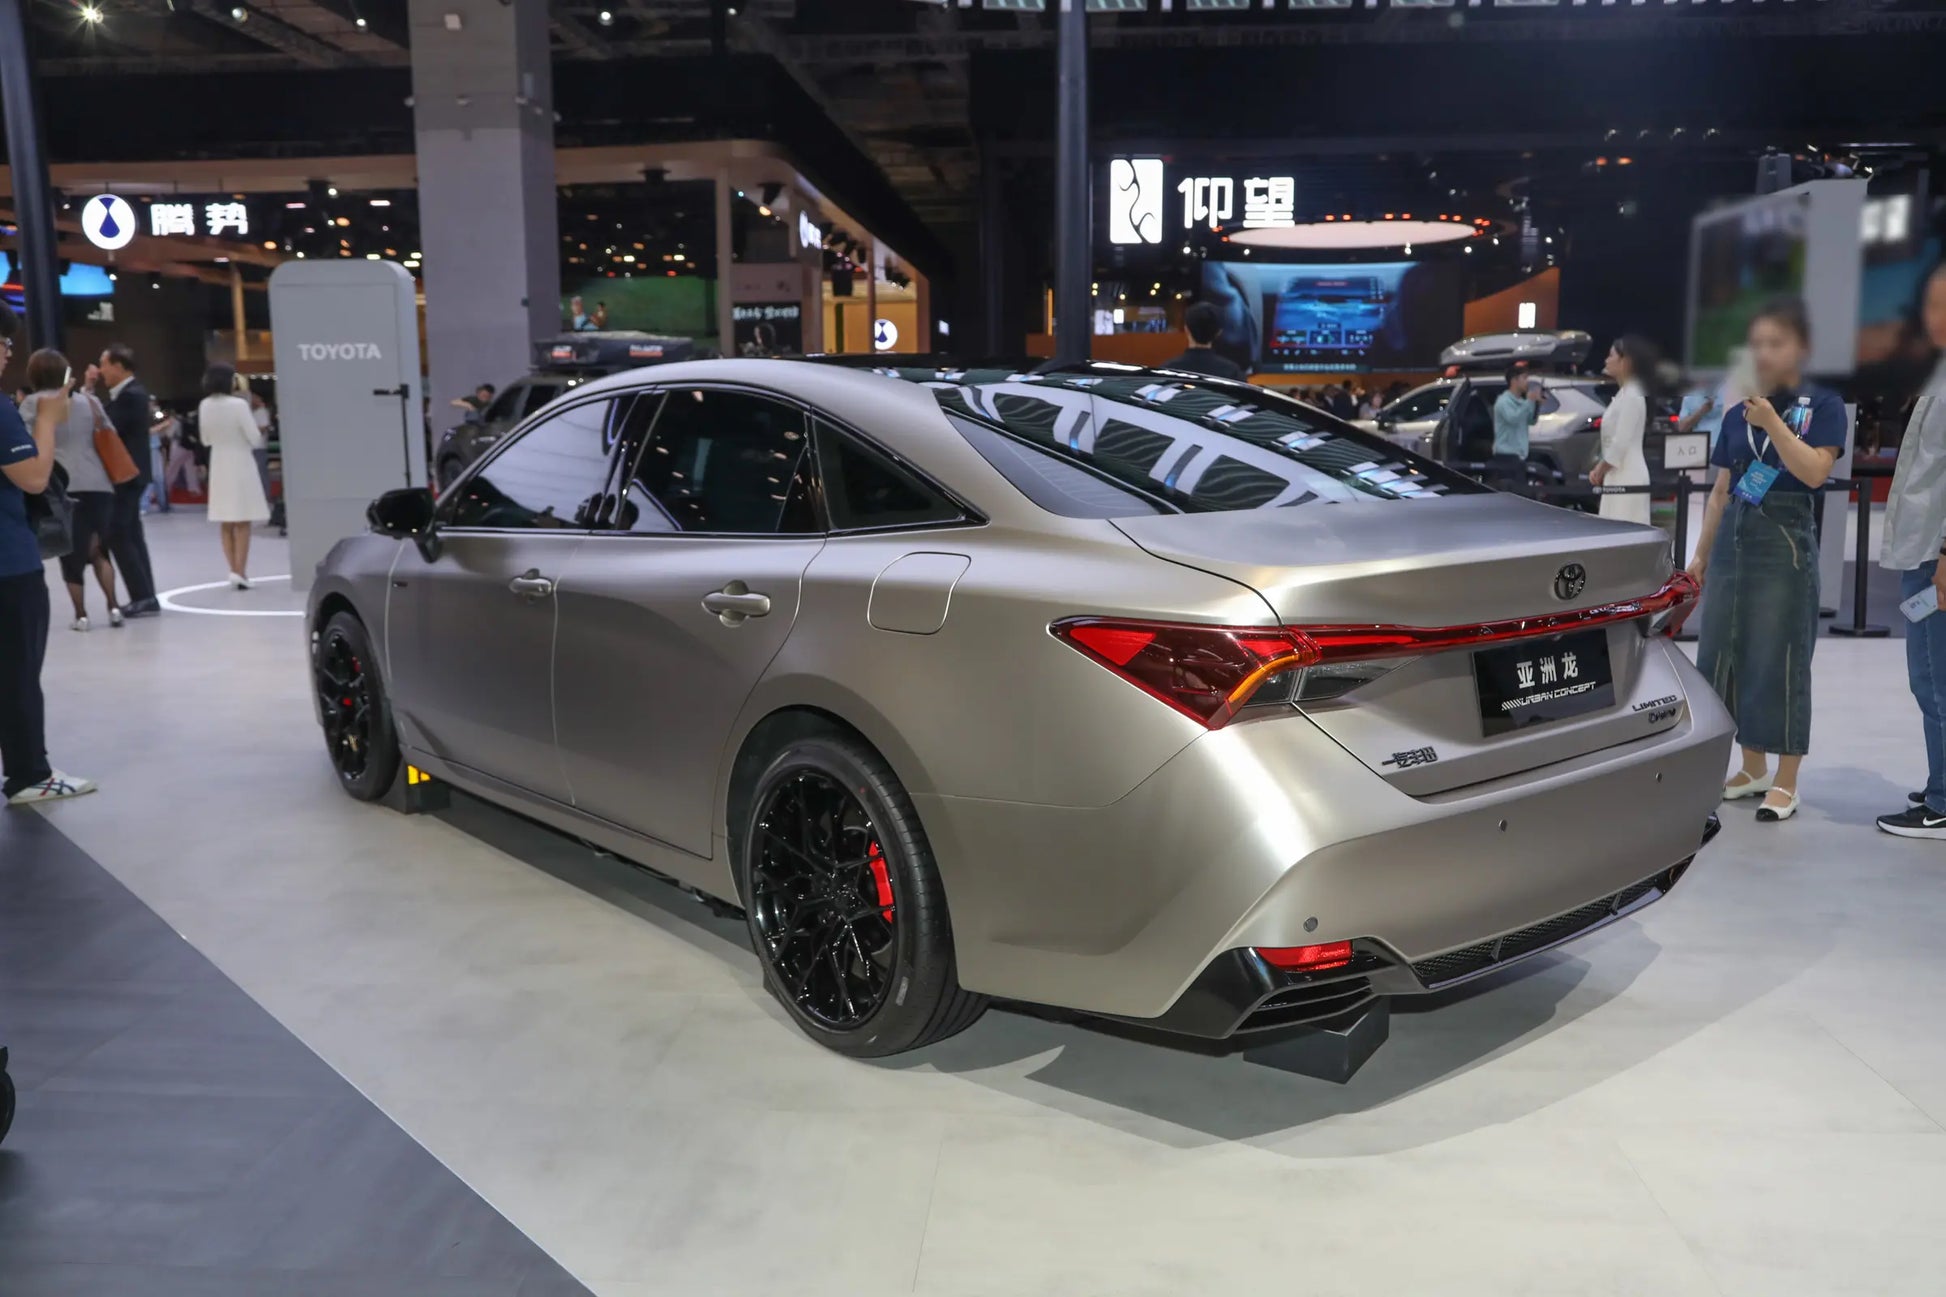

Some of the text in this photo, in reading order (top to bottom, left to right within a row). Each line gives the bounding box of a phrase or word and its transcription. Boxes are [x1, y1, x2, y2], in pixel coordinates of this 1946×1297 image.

[1177, 177, 1295, 229] 仰望
[150, 202, 249, 236] 腾势
[296, 342, 383, 361] TOYOTA
[1516, 651, 1579, 689] 亚洲龙
[1519, 681, 1597, 706] URBAN CONCEPT
[1631, 694, 1678, 712] LIMITED
